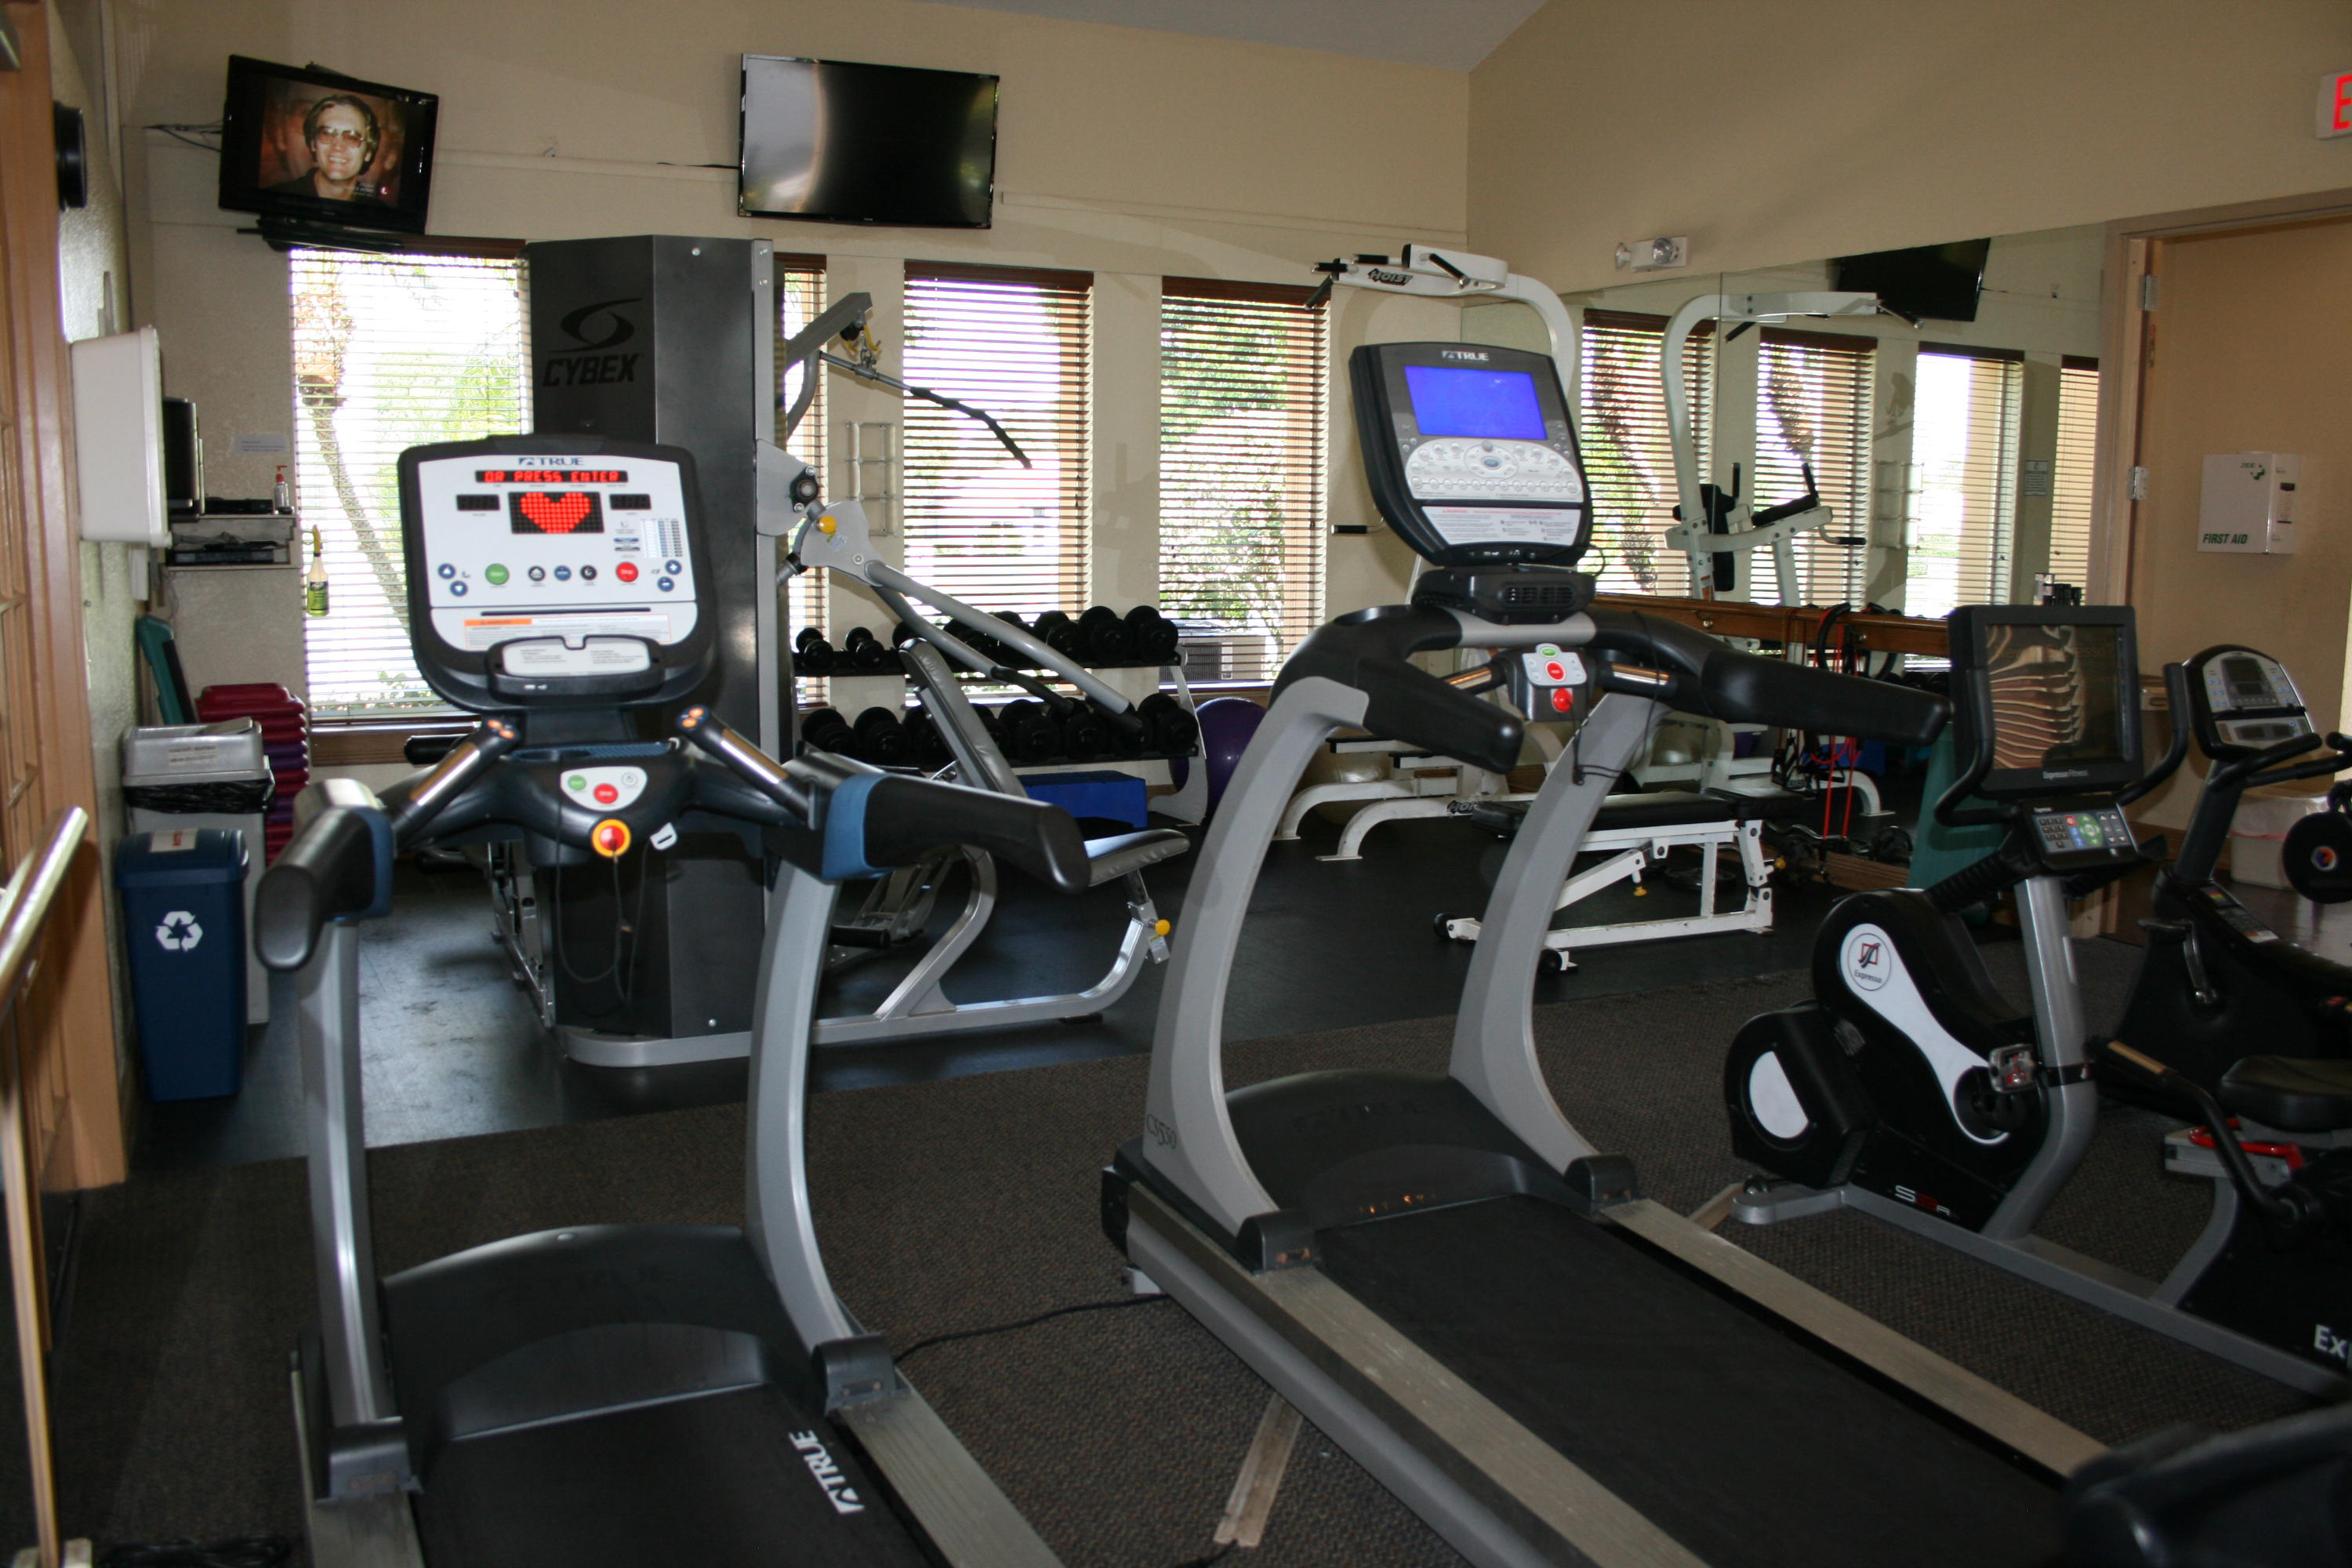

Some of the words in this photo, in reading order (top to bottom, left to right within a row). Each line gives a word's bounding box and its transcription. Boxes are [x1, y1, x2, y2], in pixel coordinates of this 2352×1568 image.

[1367, 268, 1414, 285] HOIST
[1455, 351, 1489, 361] TRUE
[543, 353, 640, 387] CYBEX
[537, 457, 584, 466] TRUE
[484, 471, 506, 483] OR
[514, 470, 563, 483] PRESS
[570, 471, 619, 483] ENTER
[2202, 534, 2230, 544] FIRST
[2230, 534, 2248, 544] AID
[1854, 969, 1882, 983] Expresso
[788, 1429, 846, 1493] TRUE
